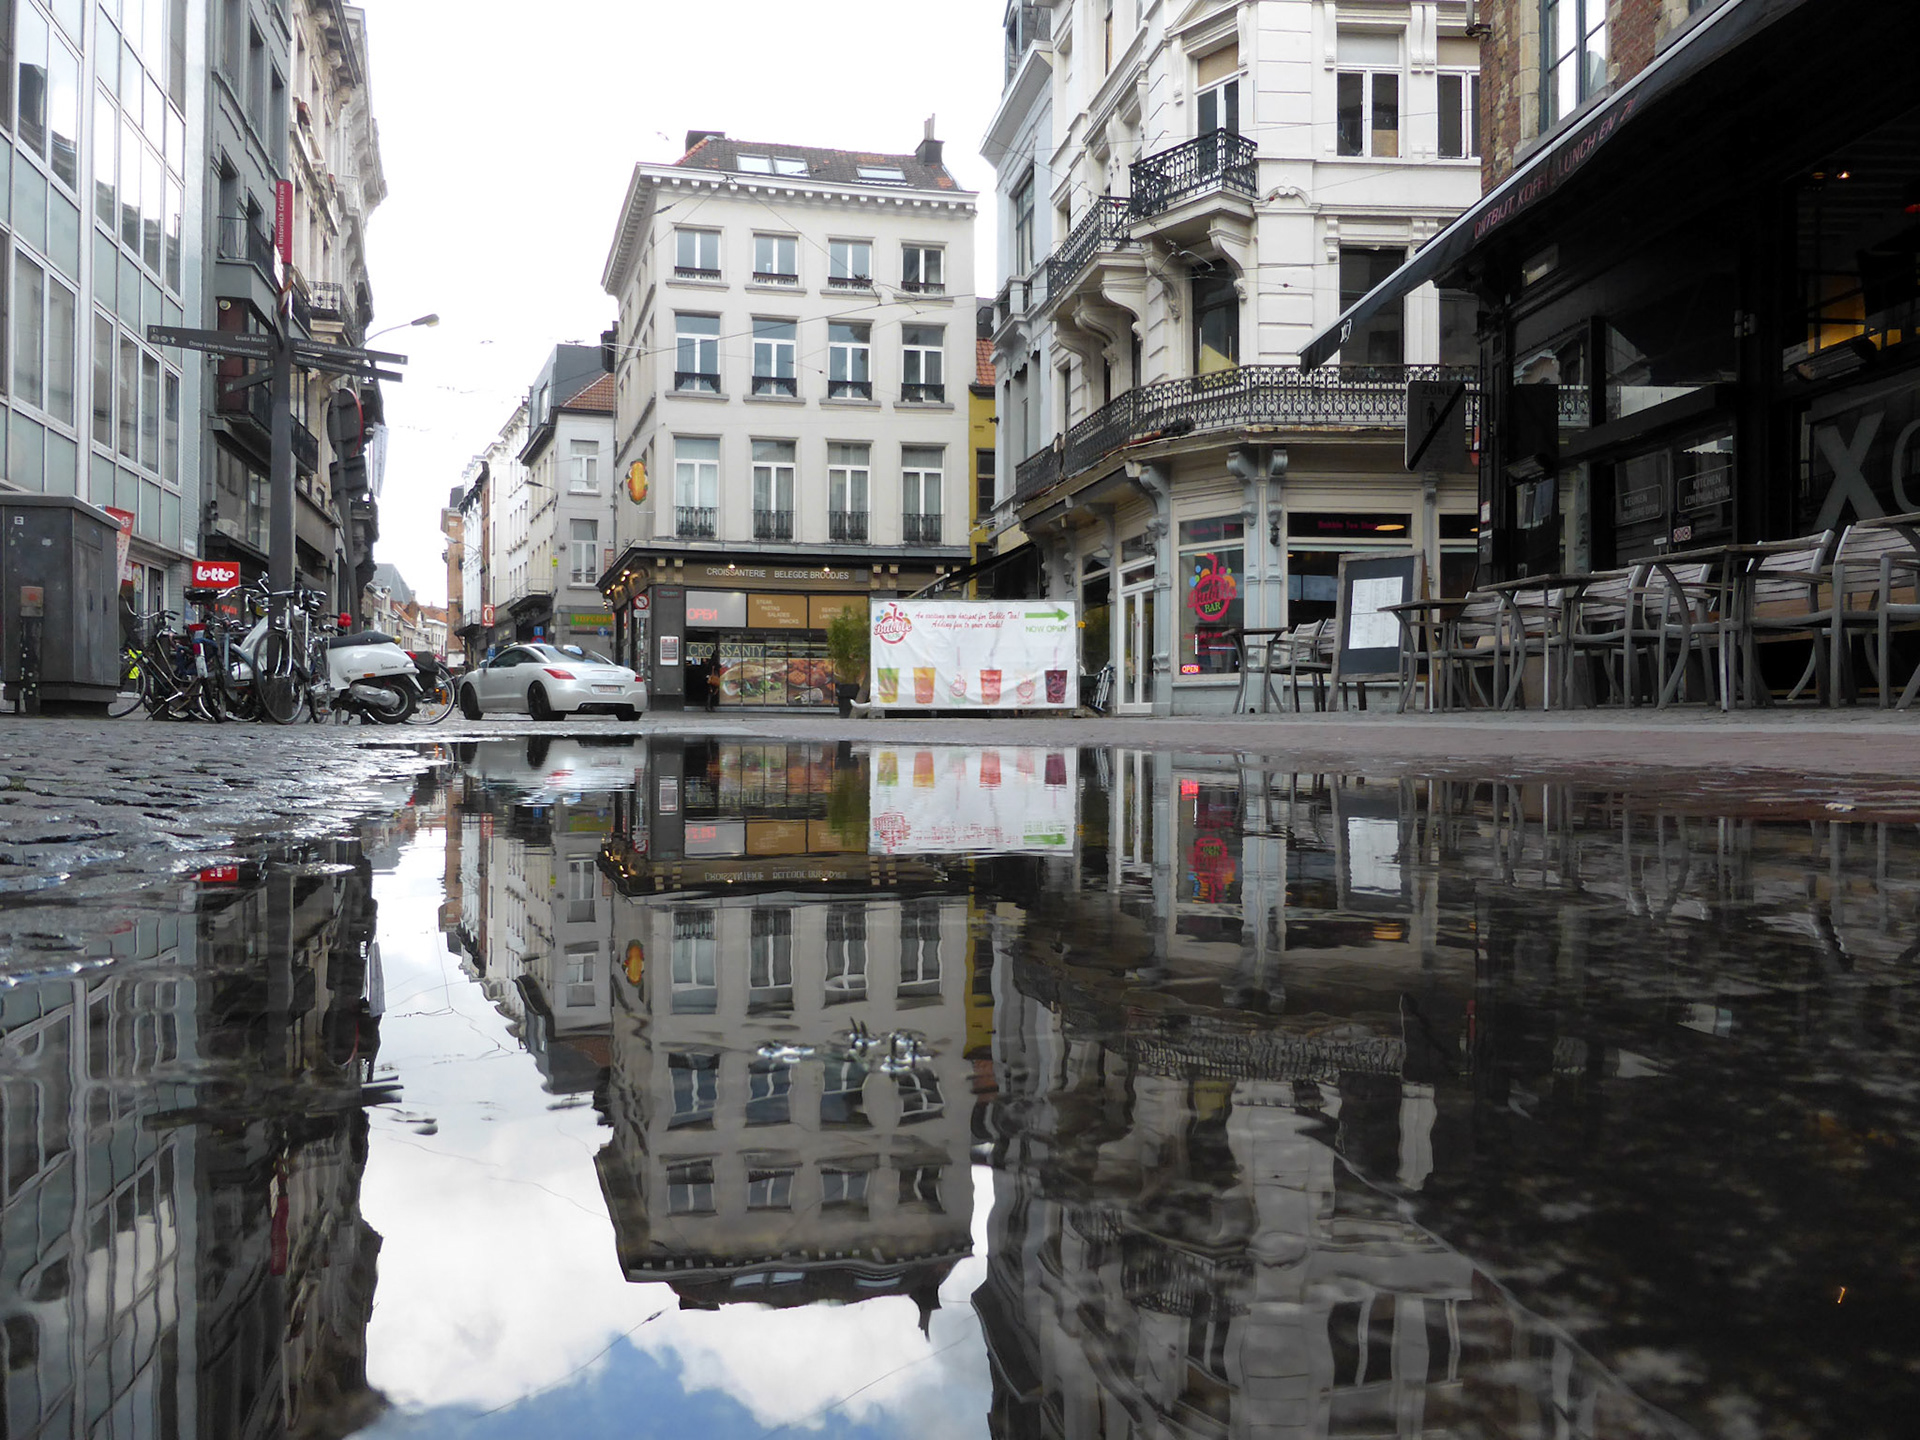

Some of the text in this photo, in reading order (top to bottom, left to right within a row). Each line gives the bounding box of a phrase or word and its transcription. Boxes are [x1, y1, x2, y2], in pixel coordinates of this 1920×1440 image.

[1558, 132, 1597, 176] LUNCH
[1598, 112, 1617, 140] EN
[1421, 385, 1452, 396] ZONE
[1693, 473, 1721, 490] KITCHEN
[1715, 486, 1730, 498] OPEN
[706, 567, 849, 580] CROISSANTERIE BELEGDE BROODJES
[1204, 601, 1221, 613] BAR
[988, 611, 1005, 619] Bubble
[873, 621, 912, 636] Bubble
[952, 620, 962, 630] fun
[1025, 624, 1067, 633] NOW OPEN
[1182, 665, 1199, 673] OPEN
